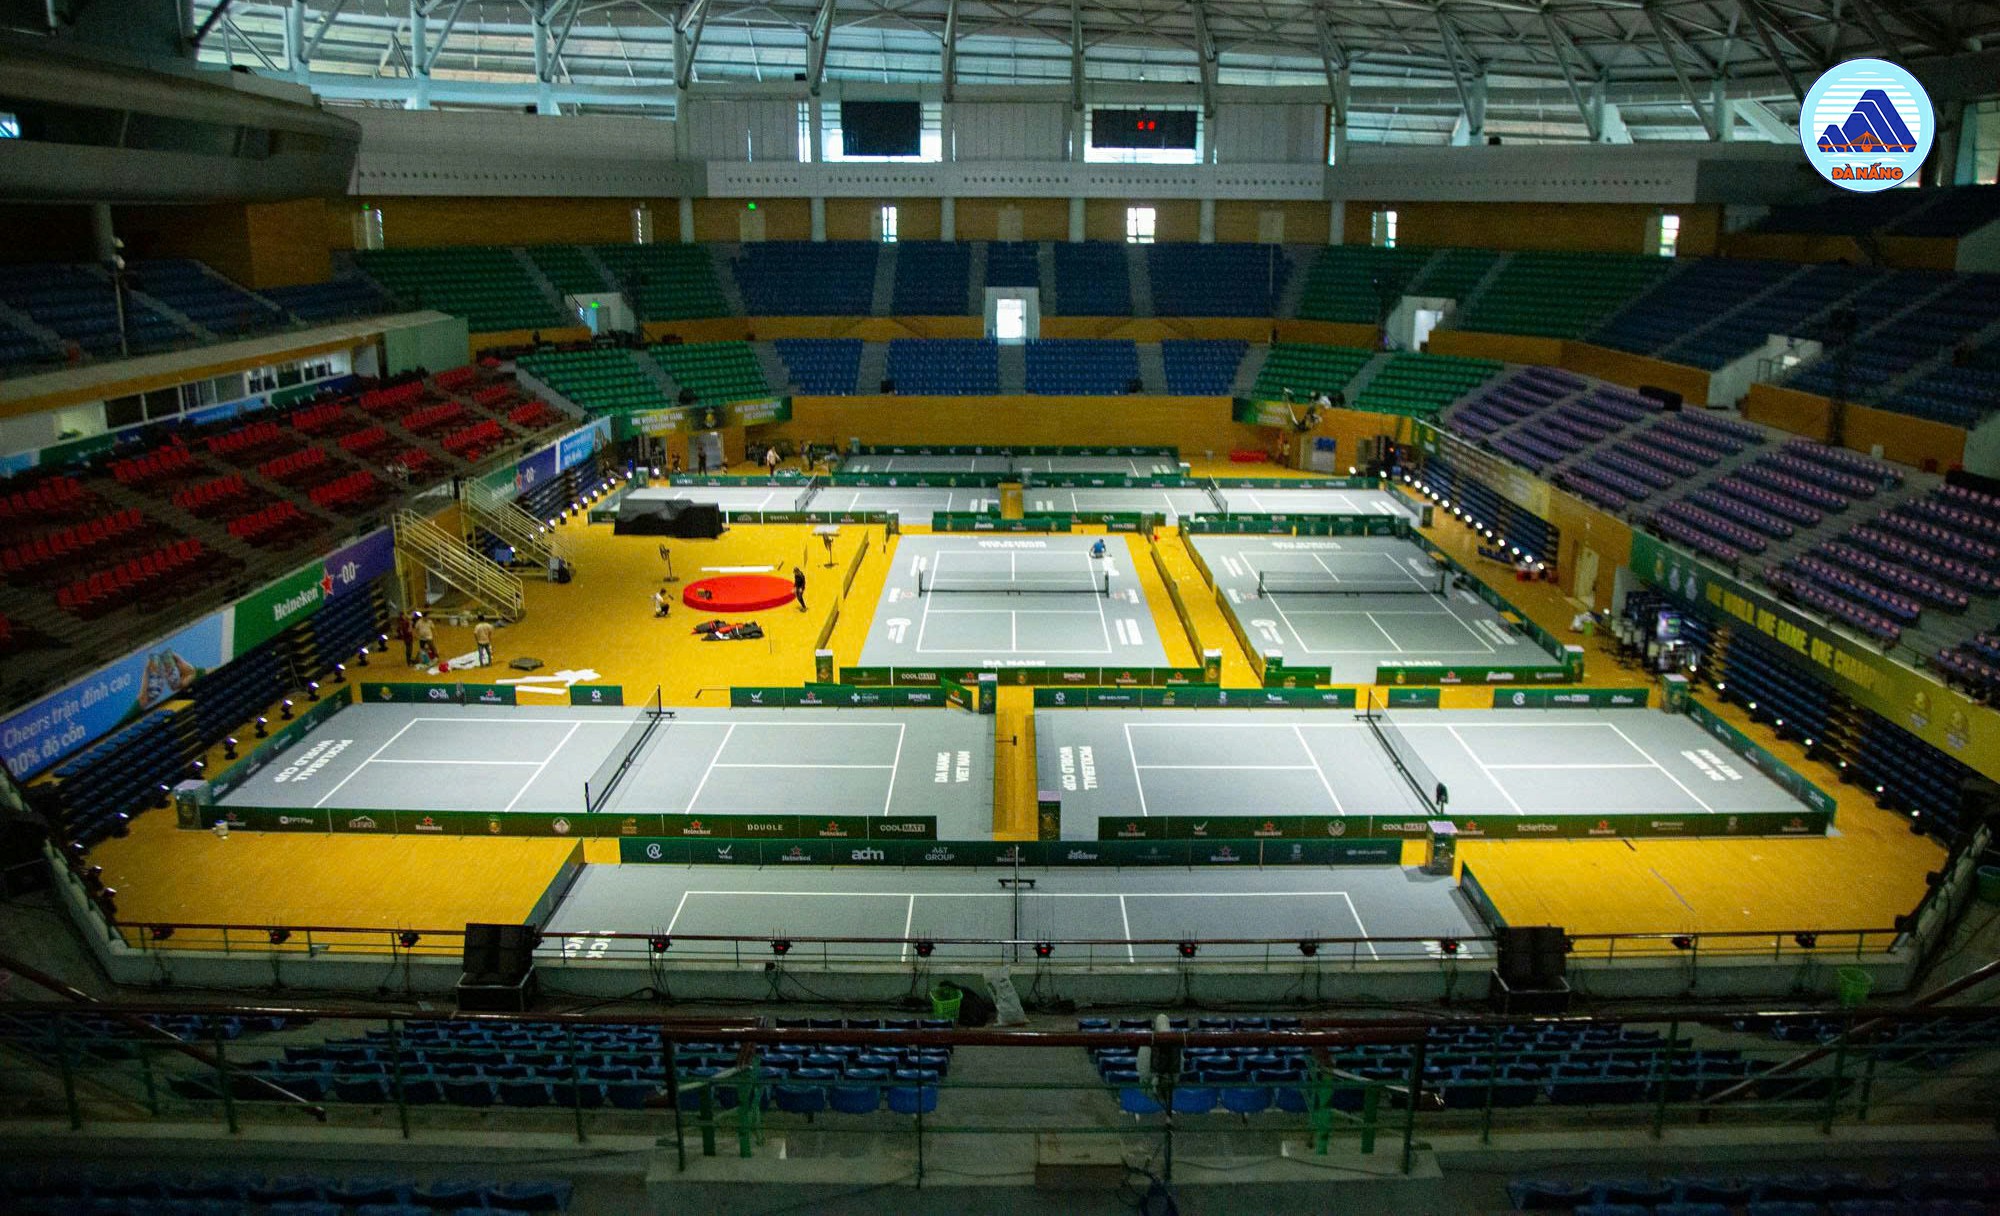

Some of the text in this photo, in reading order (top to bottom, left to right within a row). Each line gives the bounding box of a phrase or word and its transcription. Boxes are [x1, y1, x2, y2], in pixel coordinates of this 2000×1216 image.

[273, 587, 319, 621] Heineken
[4, 715, 50, 749] Cheers
[110, 673, 131, 693] cao
[851, 847, 885, 860] adm
[925, 853, 955, 861] GROUP
